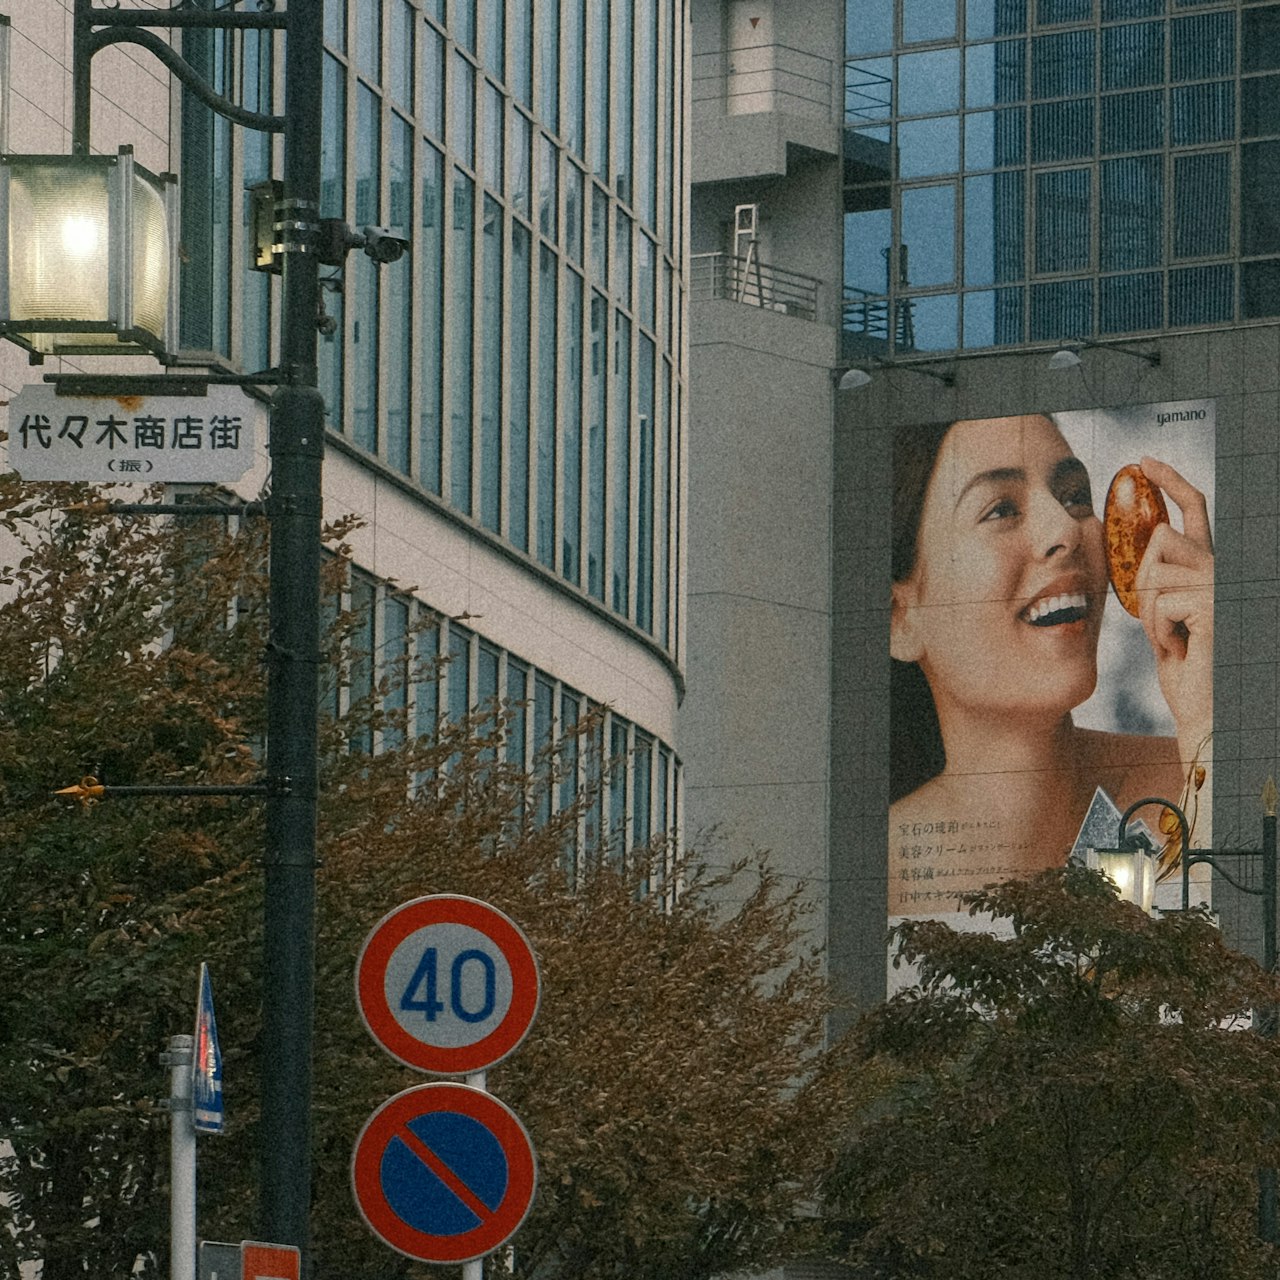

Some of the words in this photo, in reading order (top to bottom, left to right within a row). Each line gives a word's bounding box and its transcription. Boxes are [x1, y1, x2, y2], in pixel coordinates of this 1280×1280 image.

[19, 415, 242, 450] 代々木商店街
[1156, 408, 1207, 427] yamano
[401, 947, 496, 1023] 40
